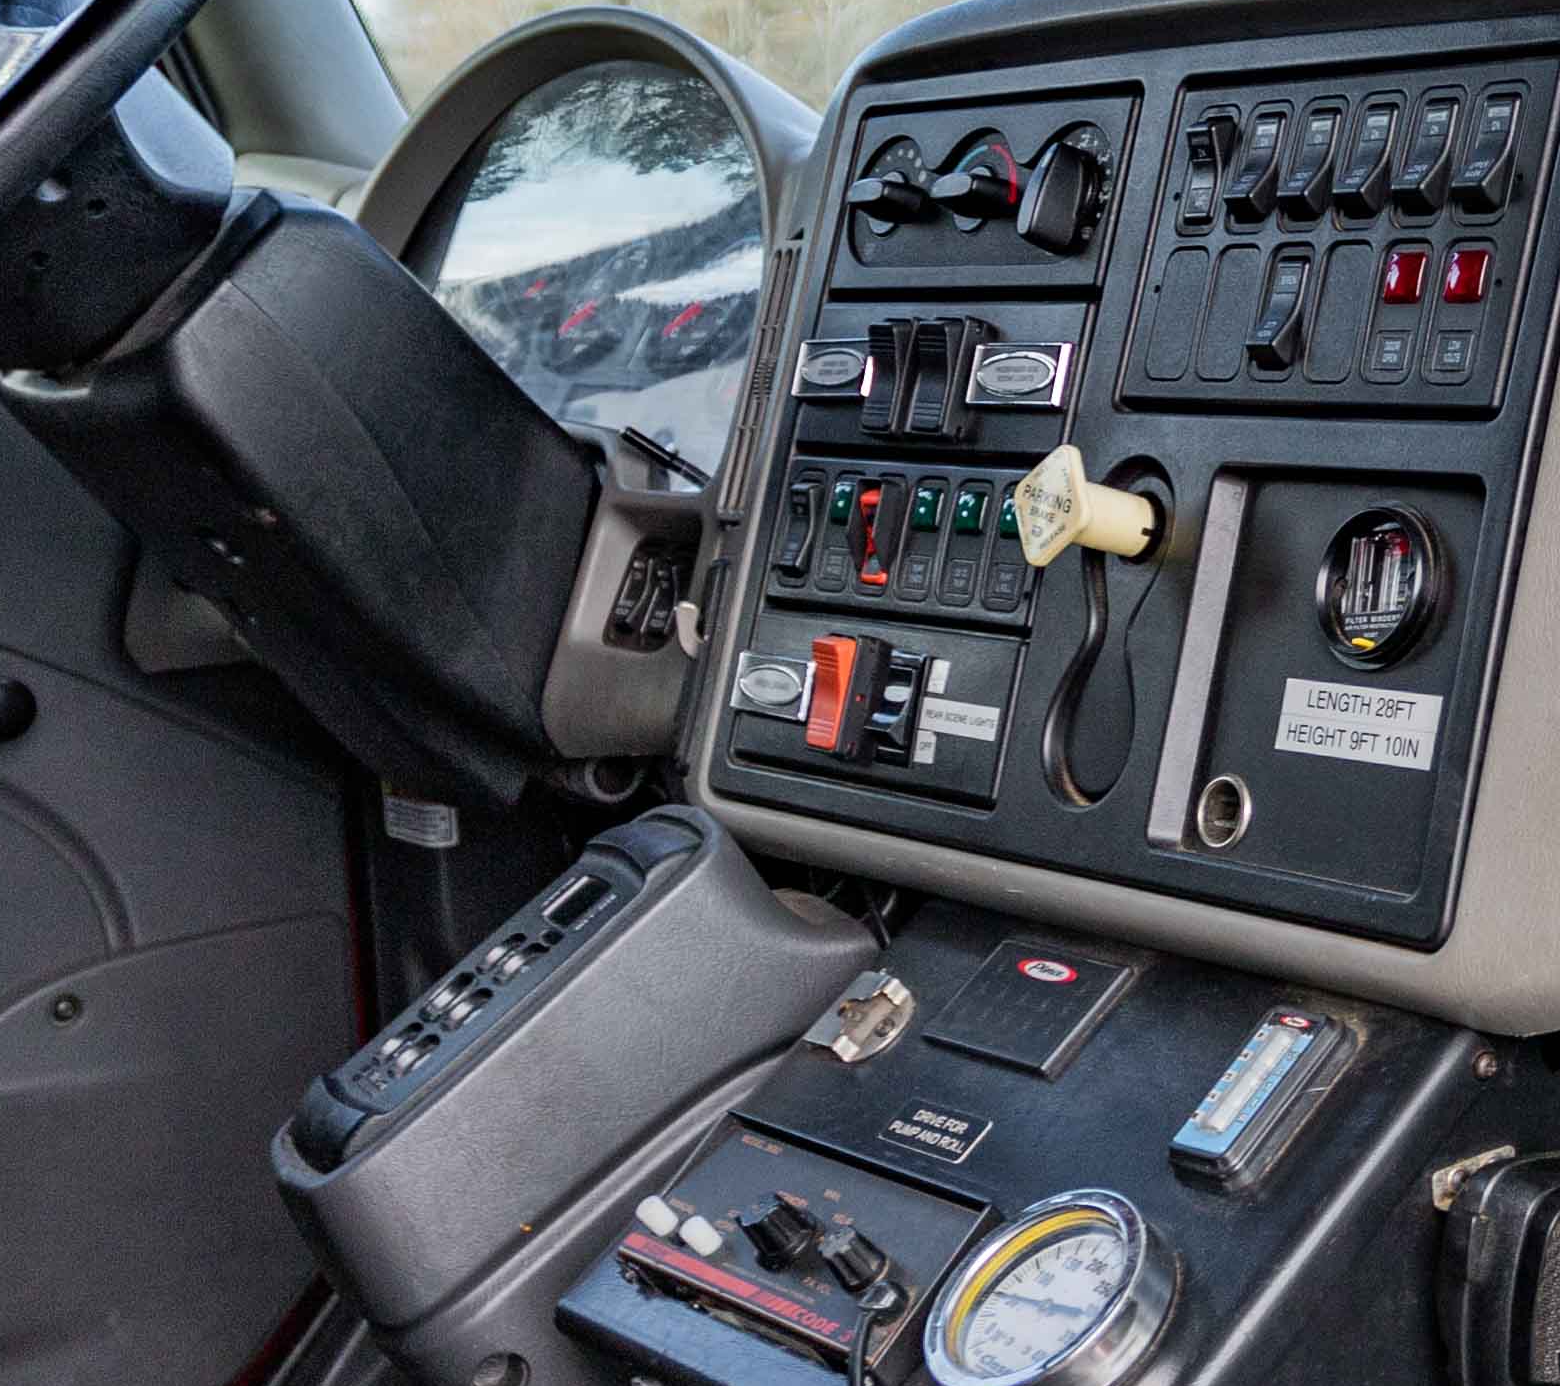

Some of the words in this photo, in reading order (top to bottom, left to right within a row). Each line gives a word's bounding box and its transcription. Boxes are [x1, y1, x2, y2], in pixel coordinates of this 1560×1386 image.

[1022, 484, 1072, 514] PARKING
[1307, 689, 1372, 714] LENGTH
[1375, 697, 1416, 721] 28FT
[969, 715, 996, 729] LIGHTS
[1286, 721, 1347, 747] HEIGHT
[1349, 730, 1380, 753] 9FT
[1385, 736, 1420, 759] 10IN
[888, 1119, 921, 1139] PUMP
[917, 1126, 941, 1146] AND
[939, 1134, 966, 1154] ROLL
[912, 1109, 945, 1127] DRIVE
[944, 1116, 969, 1134] FOR
